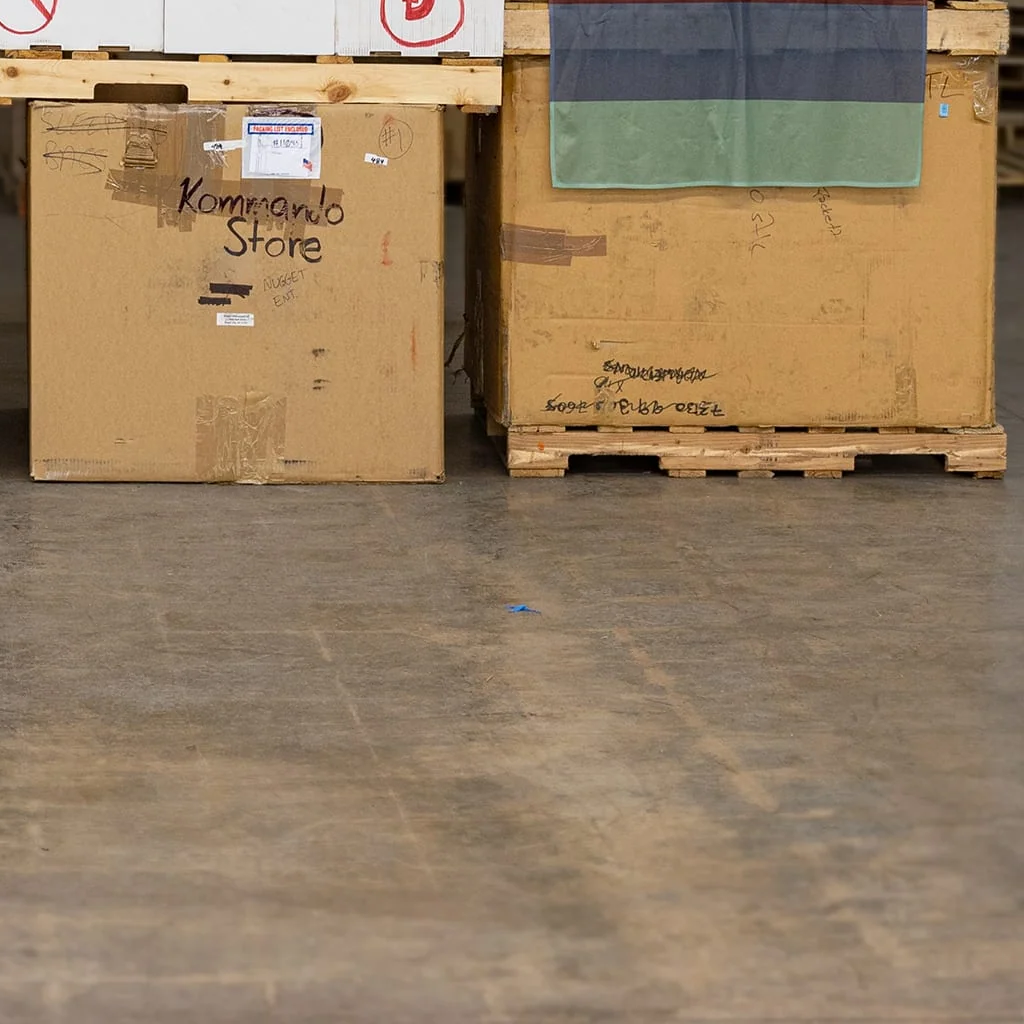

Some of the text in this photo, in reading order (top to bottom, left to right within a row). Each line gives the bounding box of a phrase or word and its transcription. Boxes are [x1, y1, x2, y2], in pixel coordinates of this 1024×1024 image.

[177, 176, 345, 225] Kommando
[223, 216, 323, 264] Store
[262, 269, 307, 292] NUGGET
